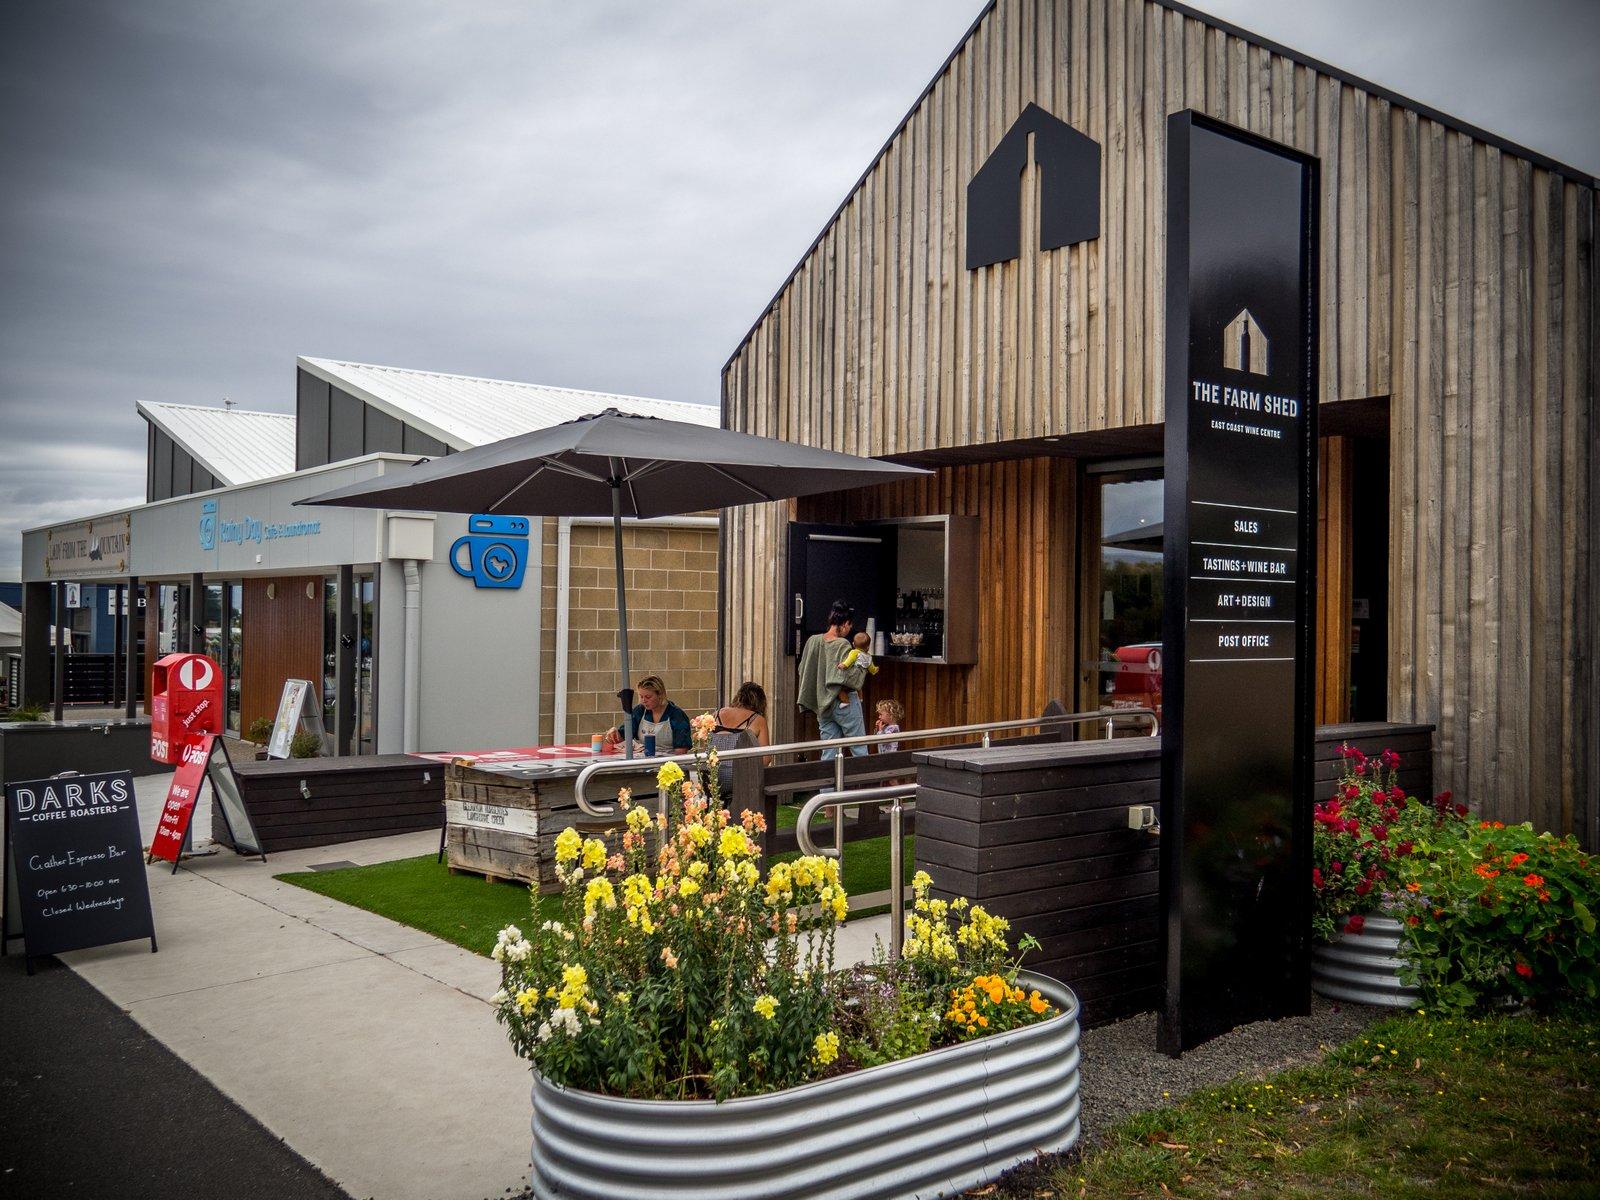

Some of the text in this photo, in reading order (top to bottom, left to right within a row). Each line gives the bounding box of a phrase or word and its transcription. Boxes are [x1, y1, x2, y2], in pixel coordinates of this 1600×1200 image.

[1193, 381, 1297, 418] THE FARM SHED
[1211, 420, 1281, 439] EAST COAST WINE CENTRE
[245, 516, 262, 544] Day
[1234, 520, 1258, 534] SALES
[1270, 562, 1286, 574] BAR
[1218, 635, 1269, 647] POST OFFICE
[182, 711, 197, 729] just
[152, 738, 169, 759] POST
[189, 749, 208, 765] POST
[16, 779, 128, 813] DARKS
[172, 785, 190, 798] We are
[32, 805, 118, 822] COFFEE ROASTERS
[29, 845, 127, 871] Gather Espresso Bar
[37, 888, 58, 900] Open
[42, 896, 125, 917] Closed Wednesdays
